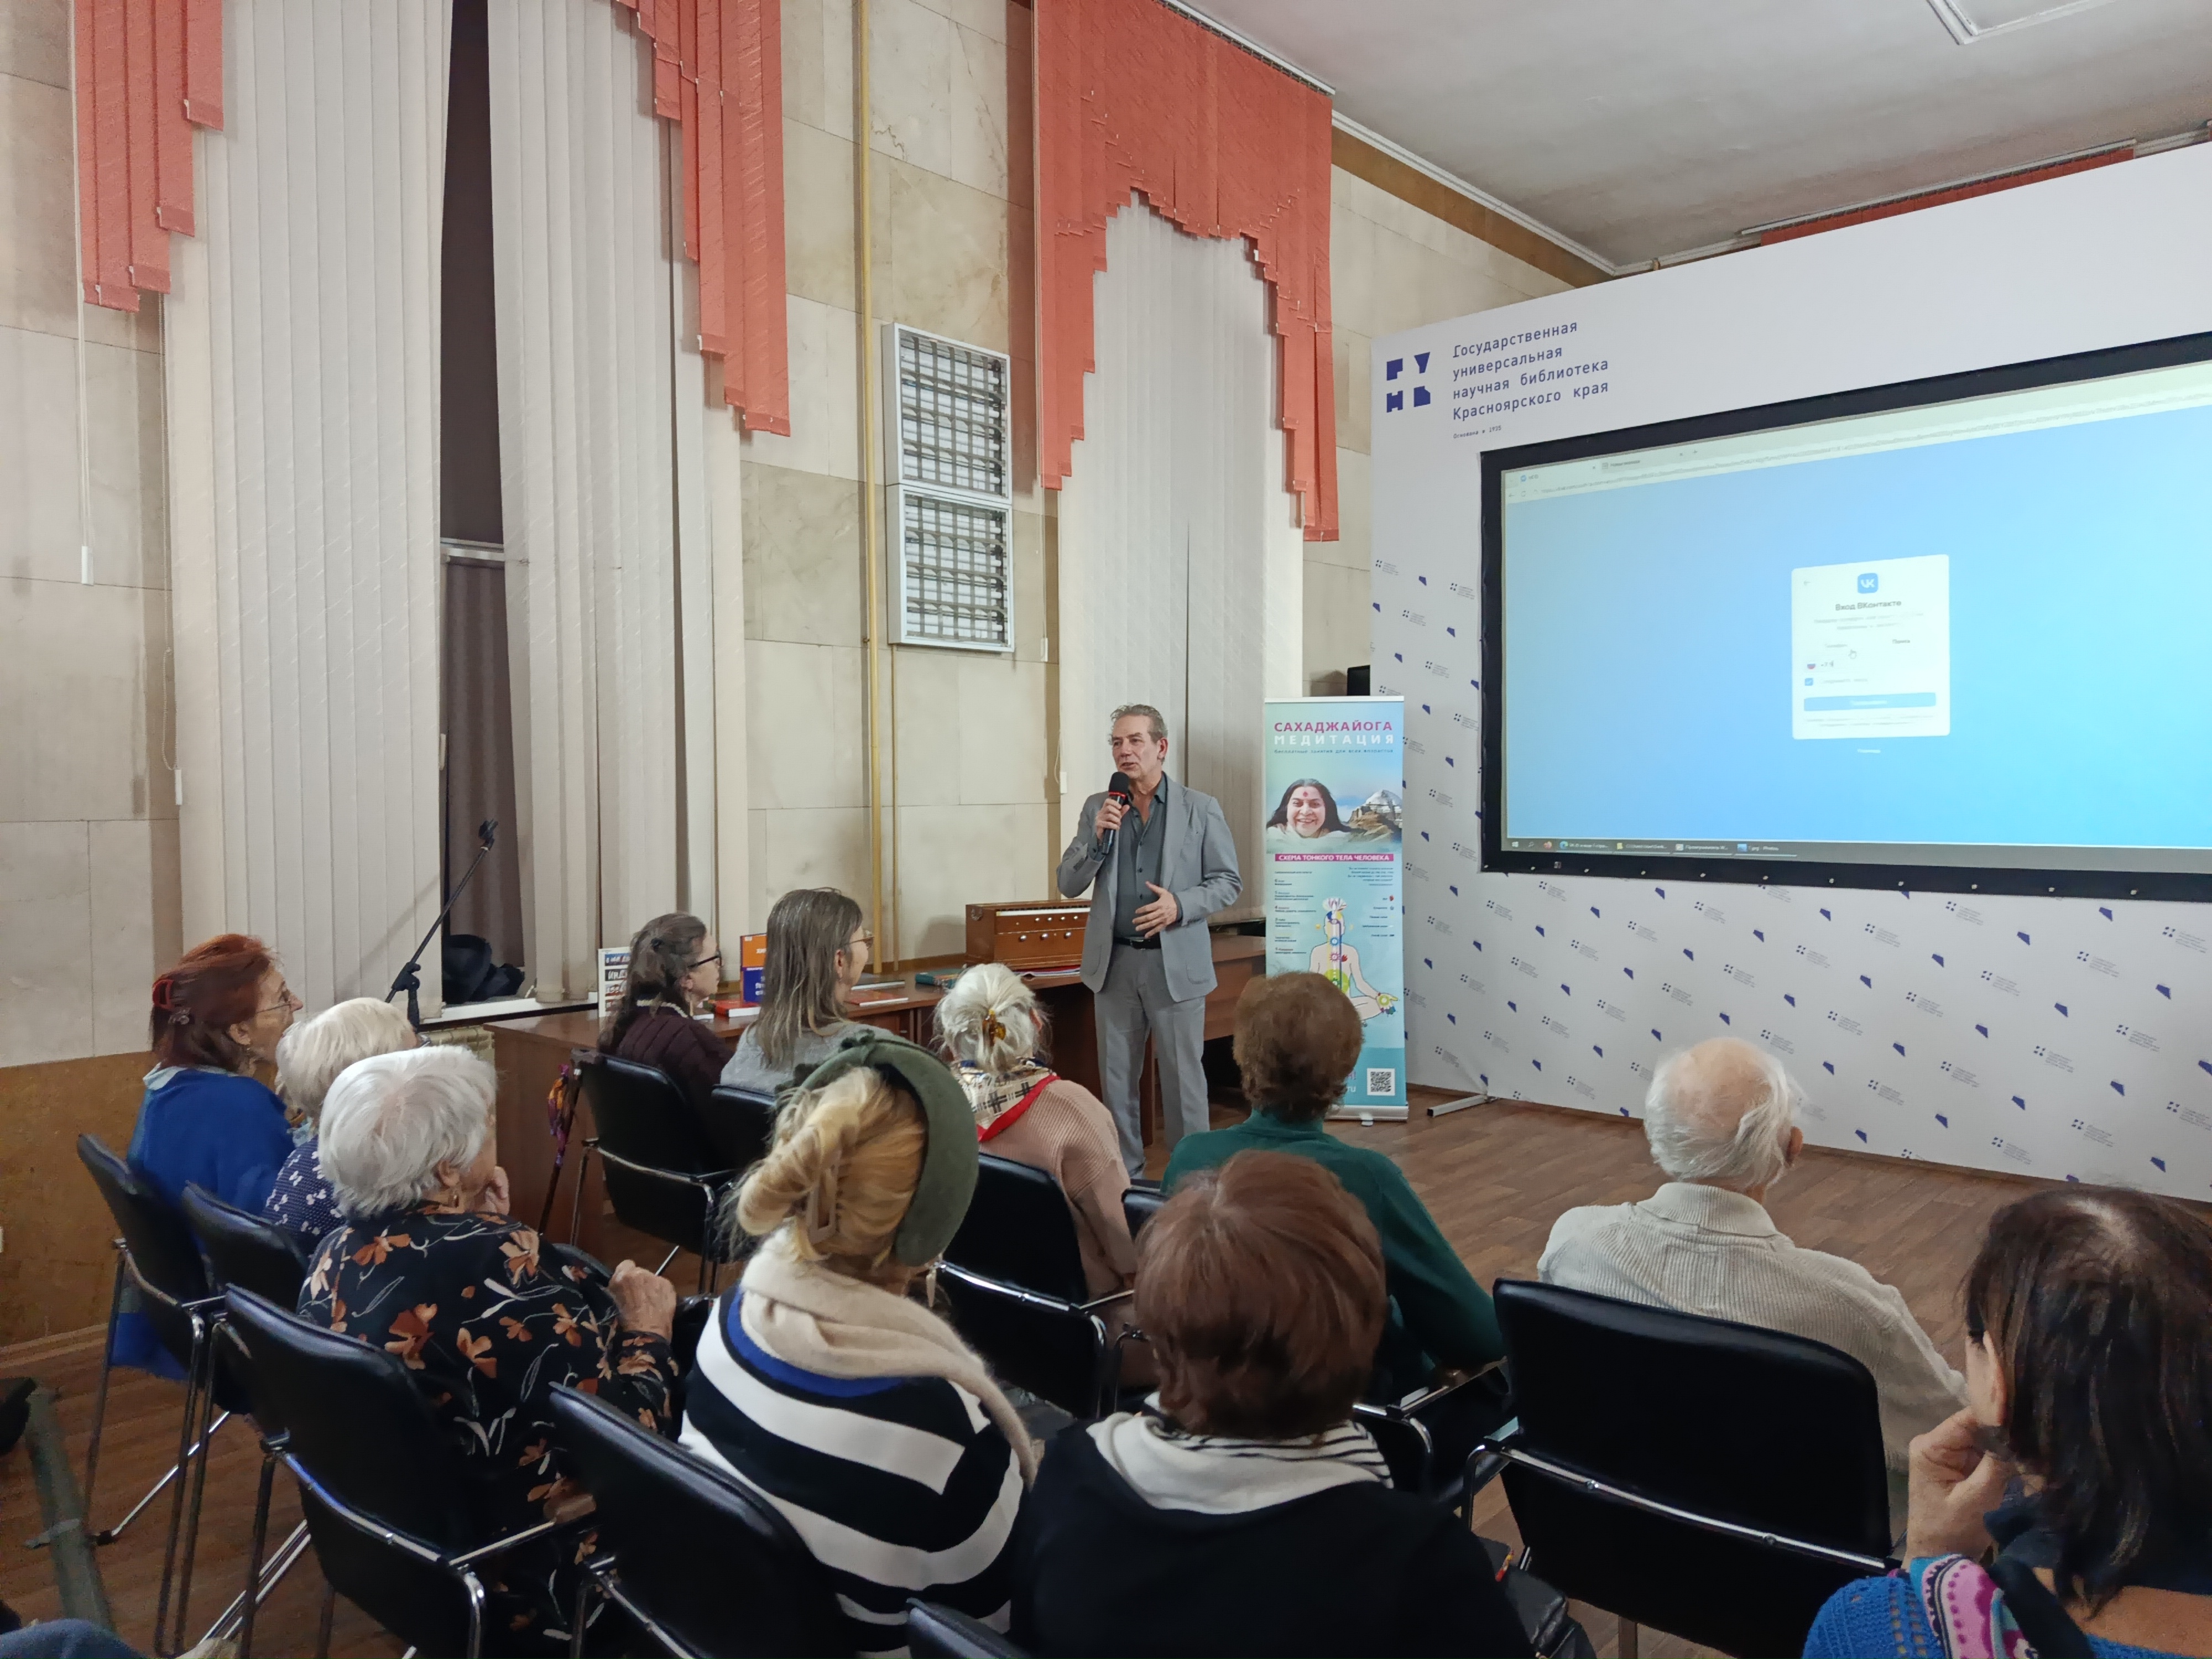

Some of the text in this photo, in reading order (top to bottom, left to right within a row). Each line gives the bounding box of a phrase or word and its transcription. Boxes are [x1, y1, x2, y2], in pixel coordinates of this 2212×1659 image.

[1453, 321, 1578, 358] Государственная
[1453, 346, 1563, 382] универсальная
[1453, 361, 1609, 400] научная библиотека
[1453, 382, 1609, 421] Красноярского края
[1453, 430, 1479, 439] Основана
[1858, 601, 1902, 609] ВКонтакте
[1274, 720, 1392, 733] САХАДЖАЙОГА
[1274, 735, 1394, 747] МЕДИТАЦИЯ
